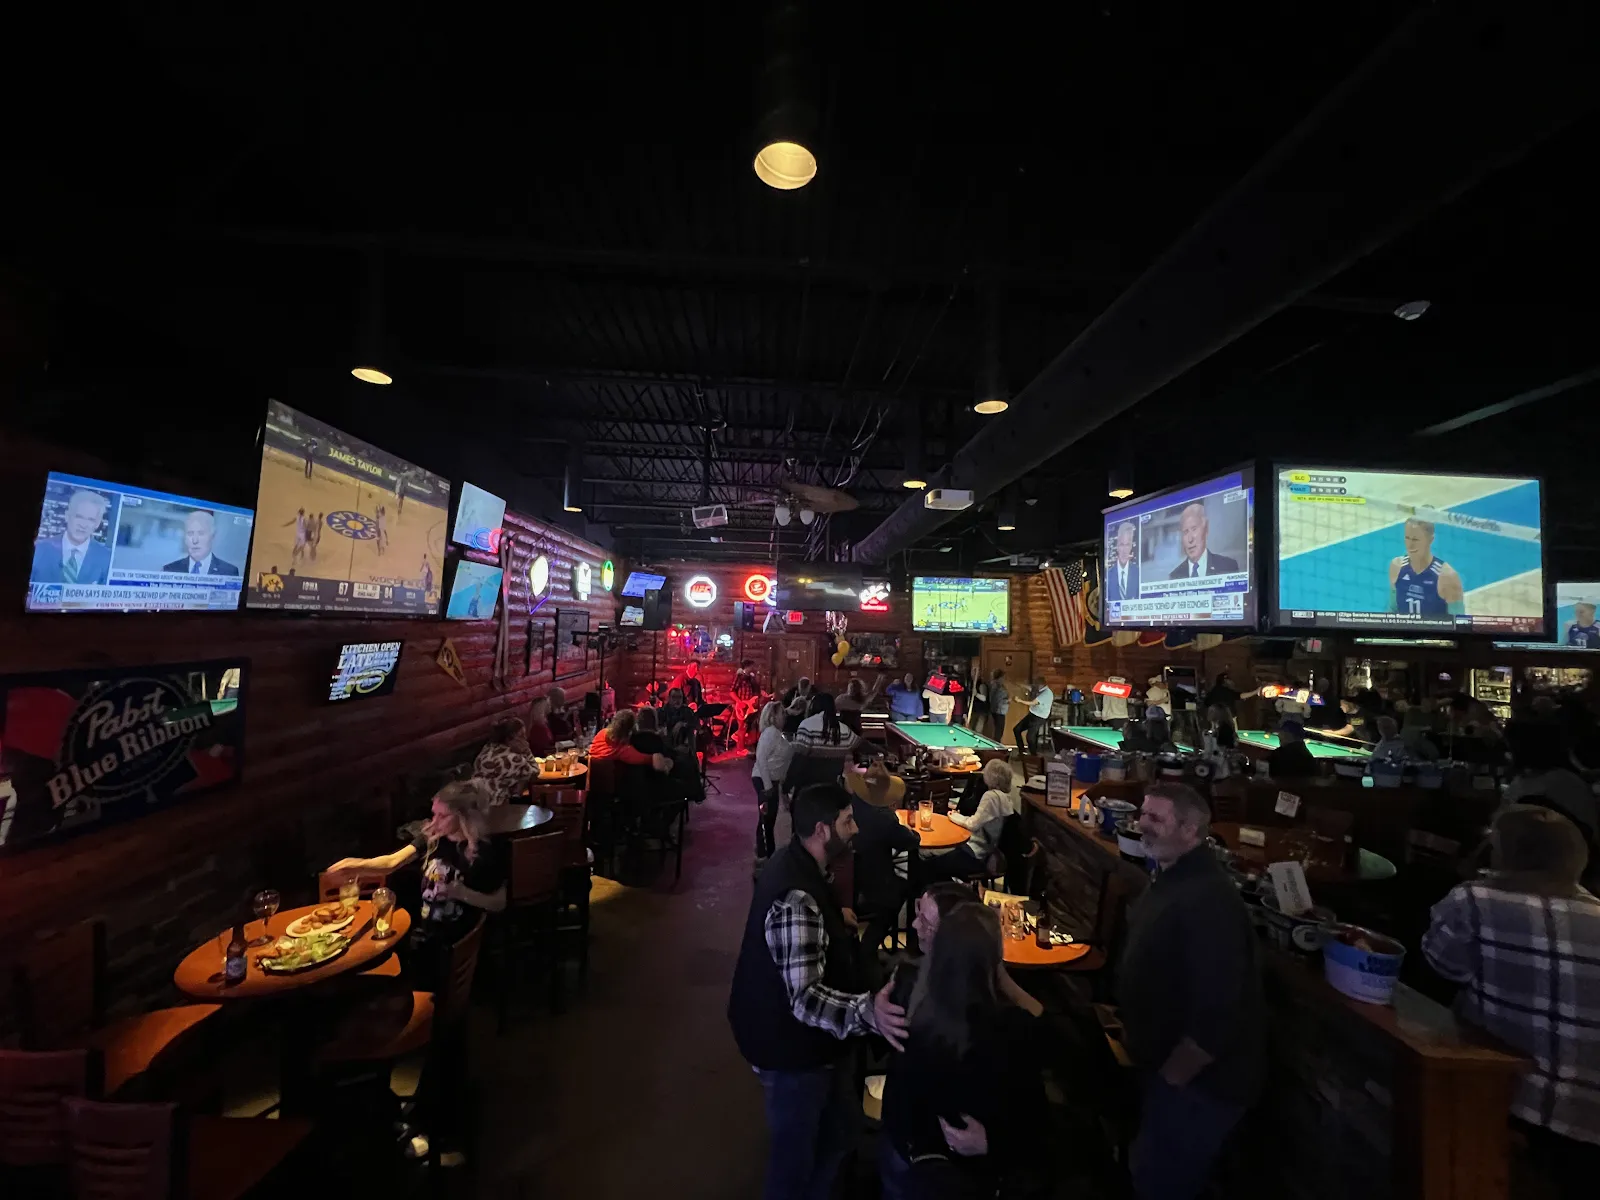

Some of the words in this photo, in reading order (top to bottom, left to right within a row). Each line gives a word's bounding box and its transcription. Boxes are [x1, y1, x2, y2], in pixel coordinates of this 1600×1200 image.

[328, 447, 356, 467] JAMES
[357, 459, 383, 477] TAYLOR
[65, 588, 84, 598] BIDEN
[85, 589, 100, 599] SAYS
[100, 590, 112, 599] RED
[112, 590, 131, 599] STATES
[302, 580, 318, 591] IOWA
[692, 585, 712, 594] UFC
[1405, 597, 1421, 614] 11
[341, 642, 380, 655] KITCHEN
[380, 641, 402, 652] OPEN
[337, 652, 375, 670] LATE
[79, 686, 168, 749] Pabst
[46, 751, 119, 810] Blue
[117, 711, 211, 763] Ribbon
